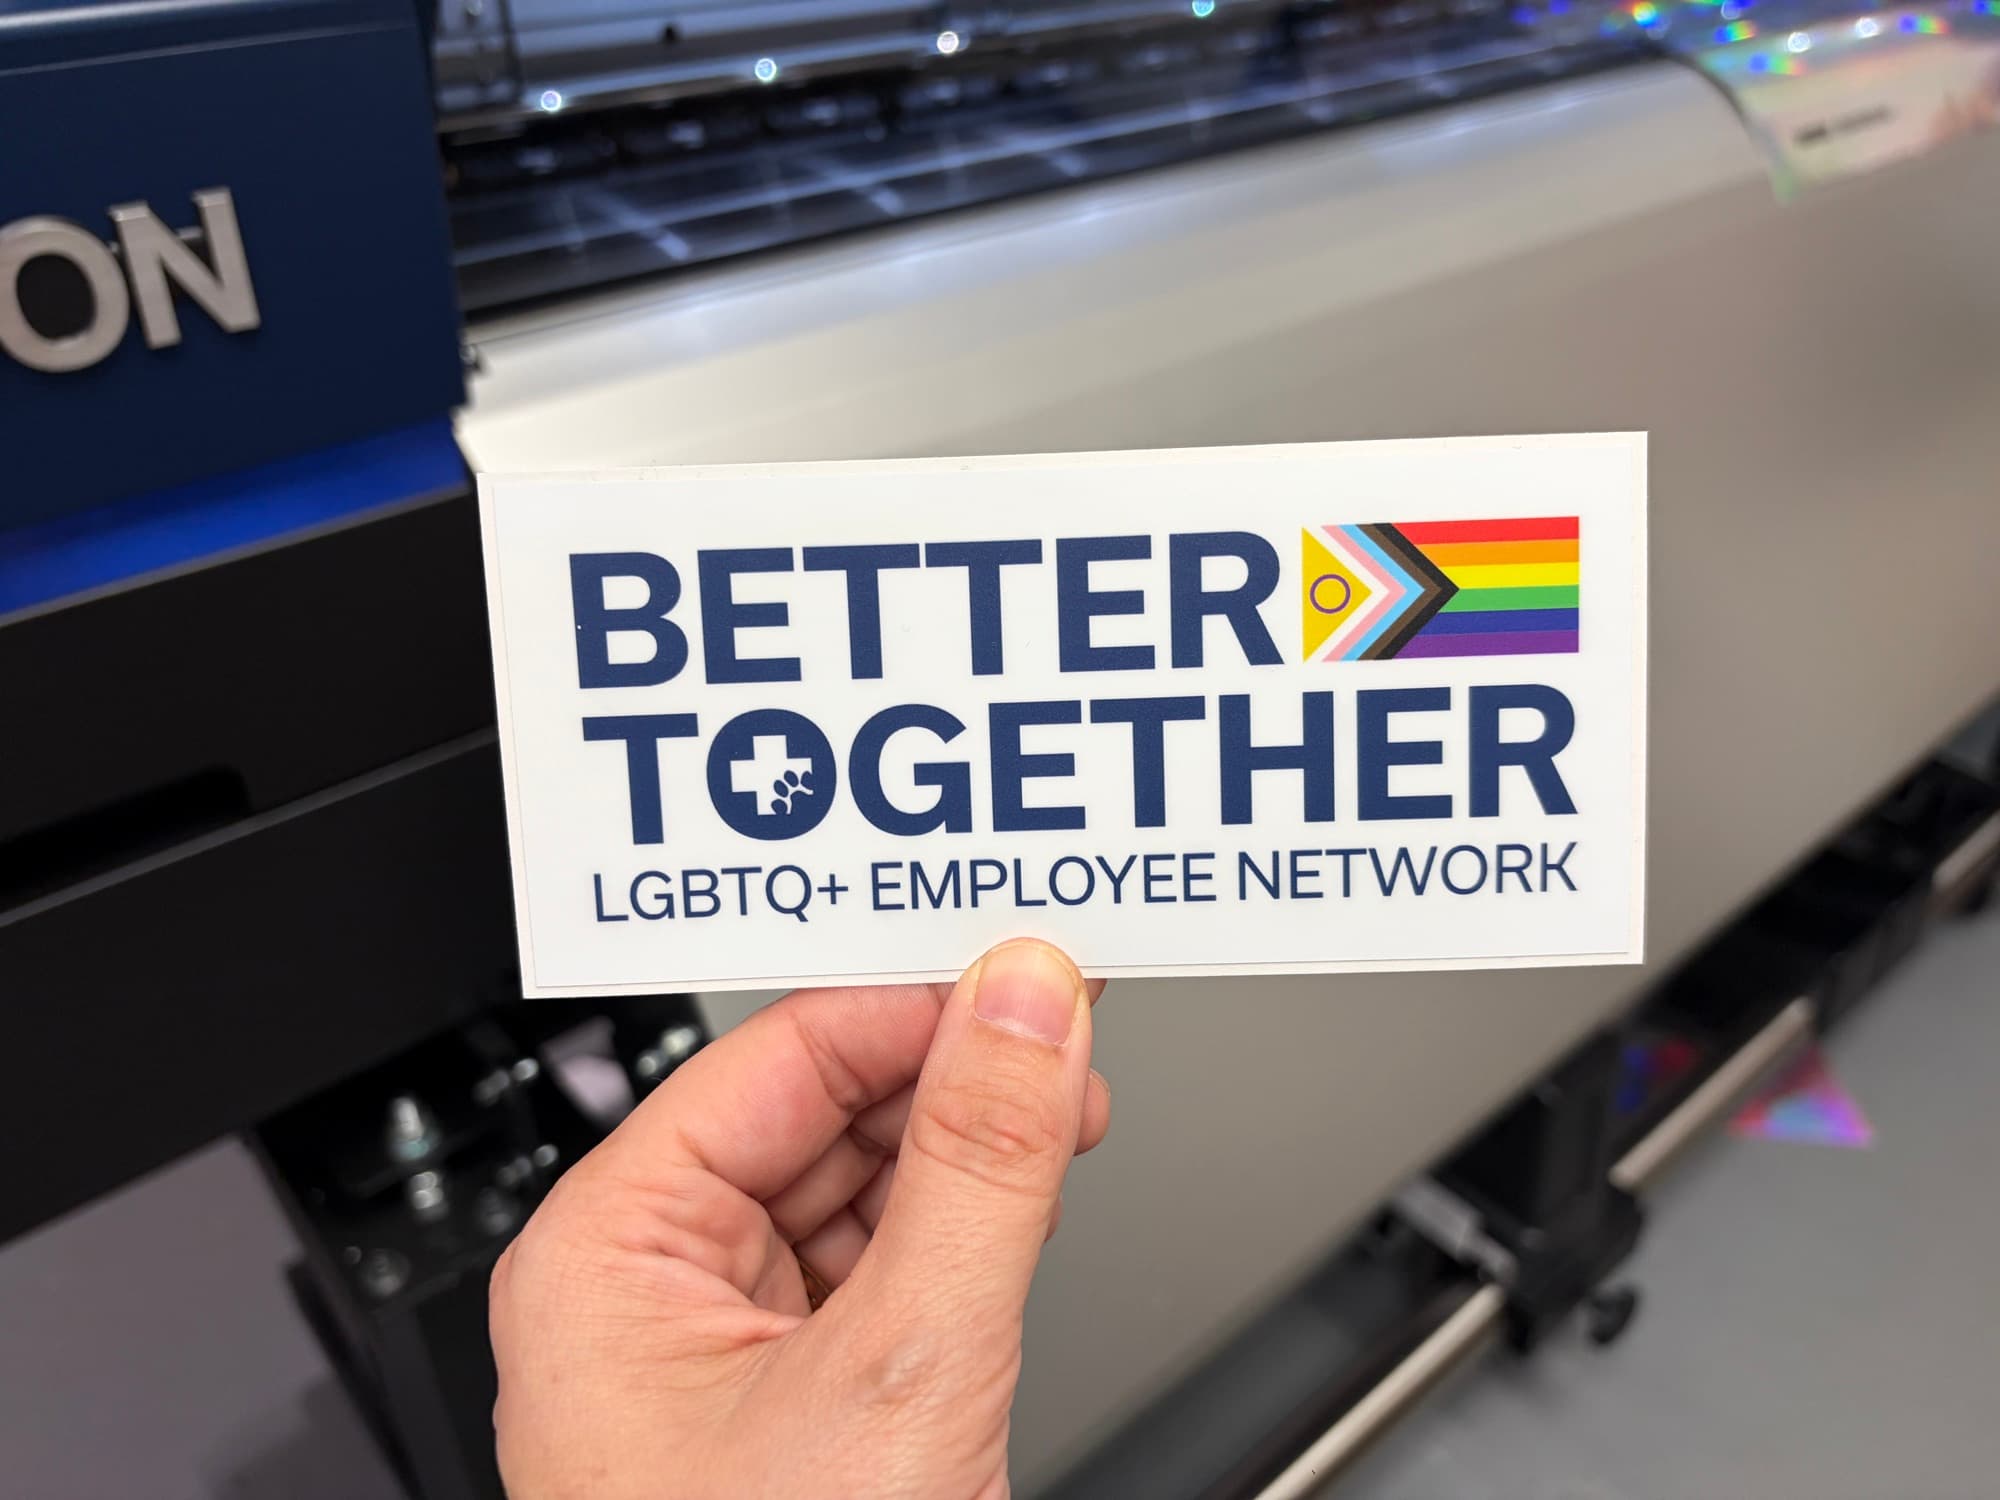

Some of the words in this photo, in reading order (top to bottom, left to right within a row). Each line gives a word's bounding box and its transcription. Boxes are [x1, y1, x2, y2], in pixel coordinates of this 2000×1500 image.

[0, 187, 261, 373] ON
[569, 531, 1285, 690] BETTER
[581, 683, 1578, 845] TOGETHER
[593, 866, 849, 923] LGBTQ+
[871, 850, 1217, 911] EMPLOYEE
[1238, 841, 1578, 901] NETWORK
